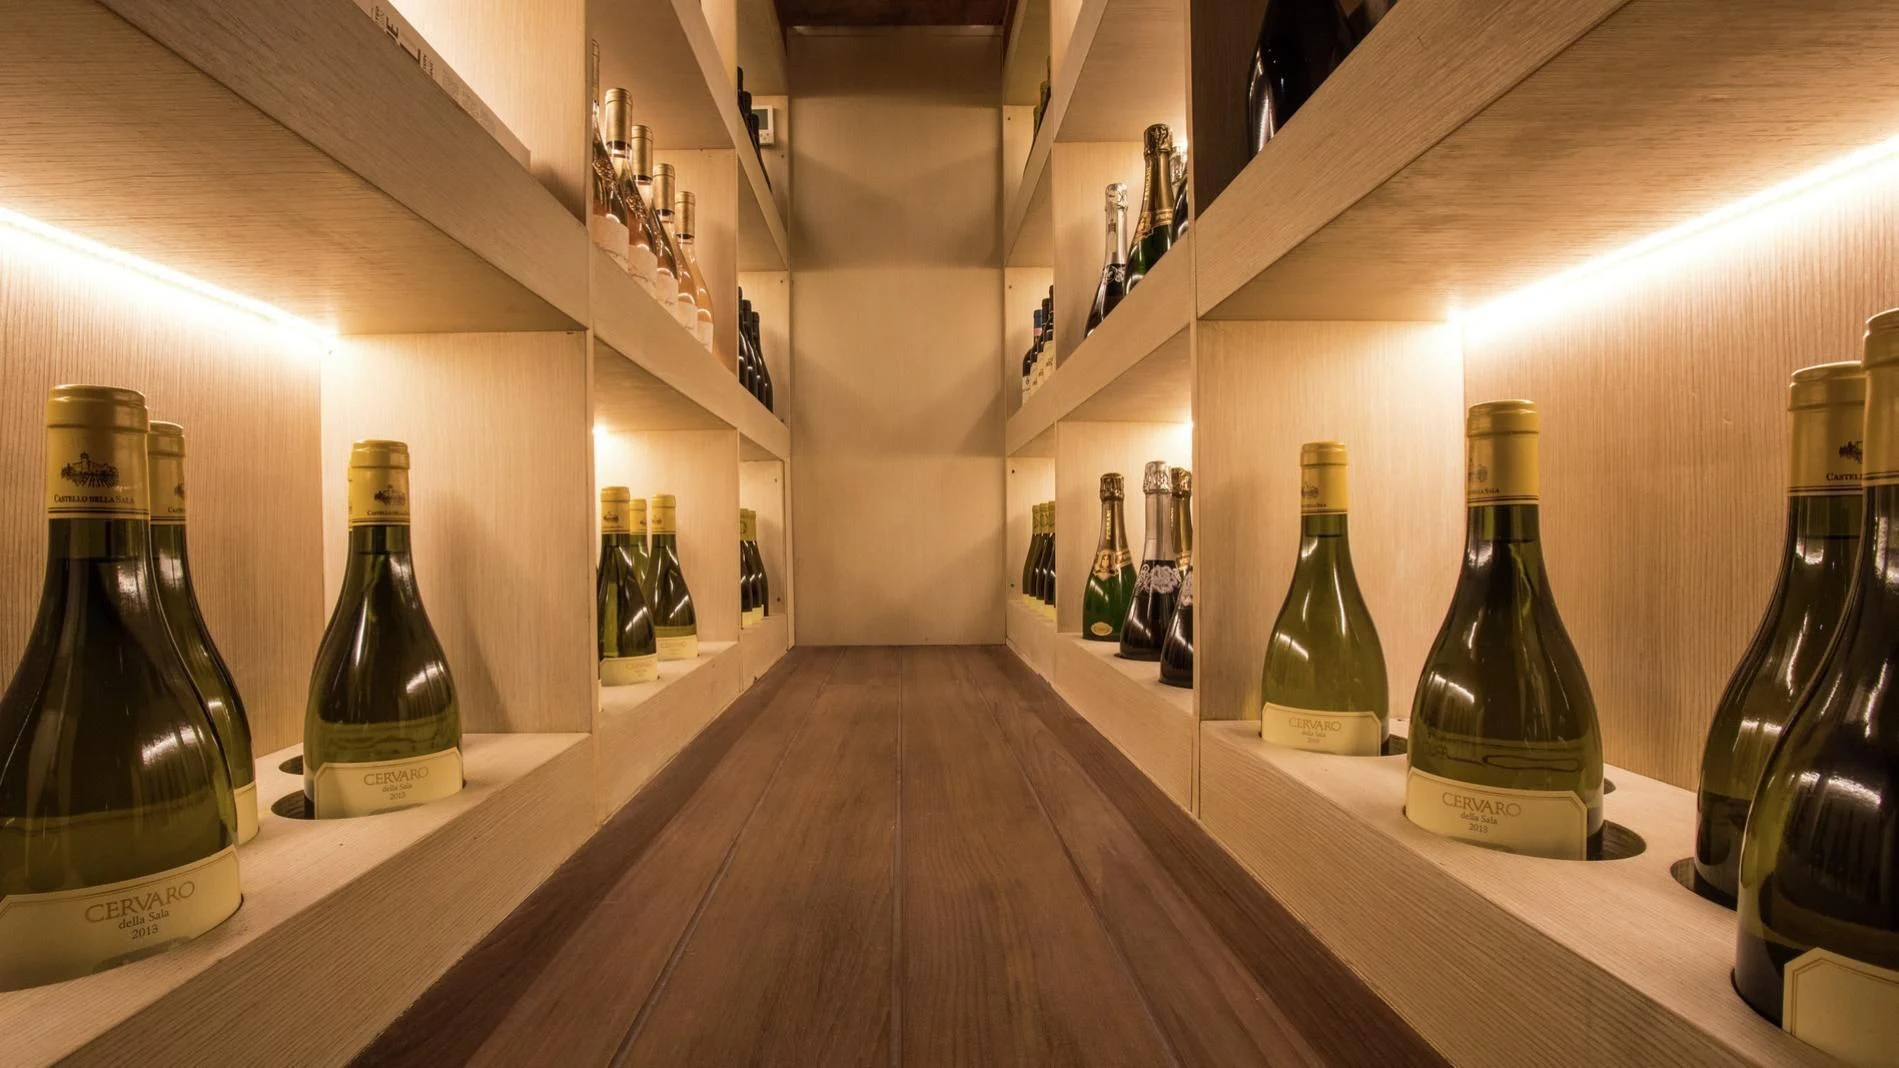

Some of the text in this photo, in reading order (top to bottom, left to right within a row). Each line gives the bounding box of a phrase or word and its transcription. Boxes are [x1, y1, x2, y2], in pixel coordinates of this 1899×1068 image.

[1288, 716, 1342, 732] CERVARO
[363, 766, 429, 786] CERVARO
[1441, 791, 1522, 817] CERVARO
[84, 880, 196, 923] CERVARO
[118, 908, 170, 930] della Sala
[131, 923, 159, 940] 2013
